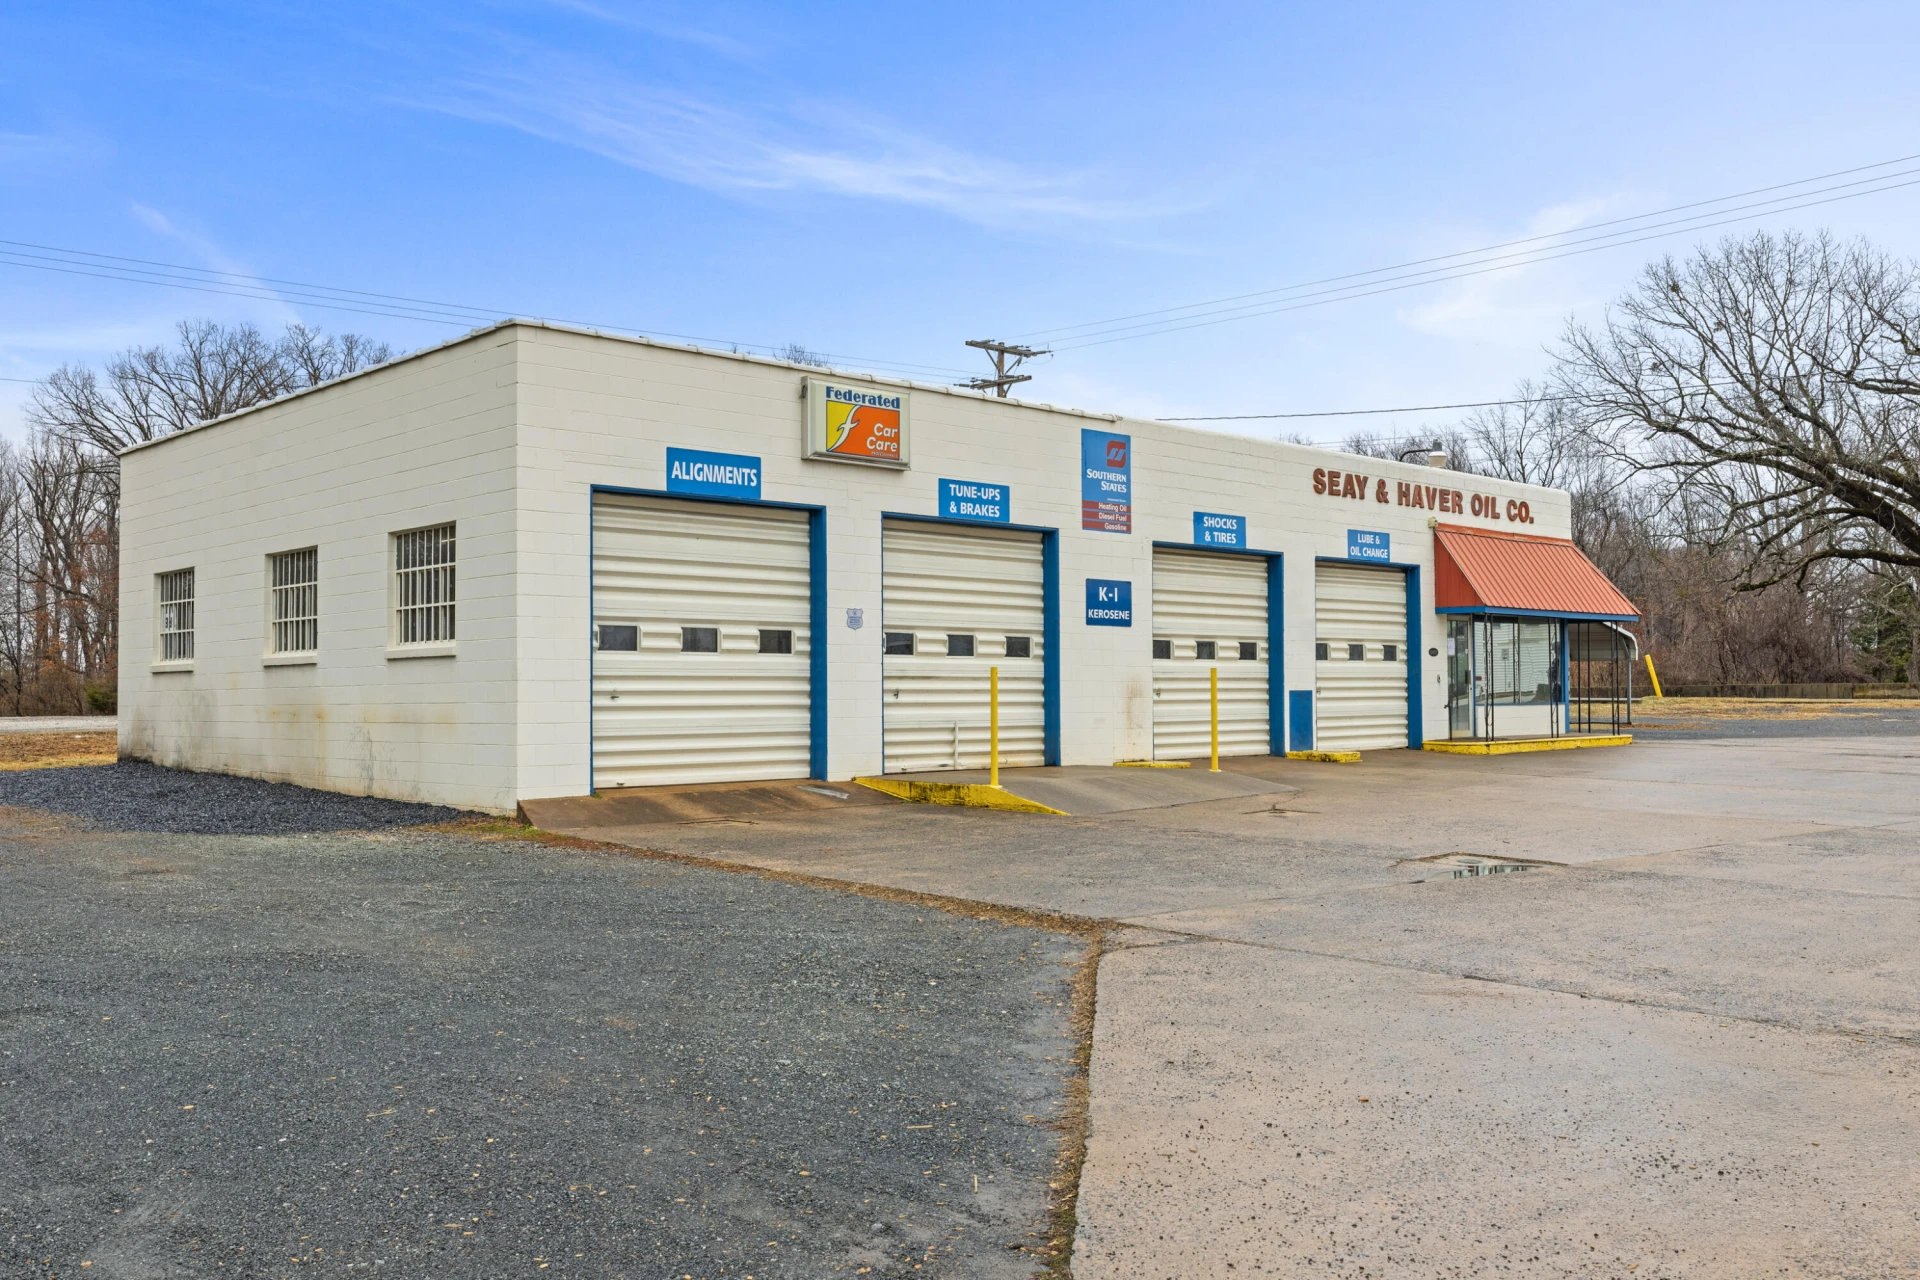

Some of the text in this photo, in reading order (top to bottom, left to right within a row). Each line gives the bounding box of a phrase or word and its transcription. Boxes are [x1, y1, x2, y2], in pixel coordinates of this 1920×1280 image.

[826, 386, 900, 409] Federated
[874, 423, 898, 438] Car
[866, 436, 898, 452] Care
[671, 461, 757, 487] ALIGNMENTS
[1086, 468, 1127, 482] SOUTHERN
[949, 484, 1000, 501] TUNE-UPS
[1101, 480, 1127, 493] STATES
[1313, 468, 1534, 524] SEAY & HAVER OIL CO.
[950, 501, 1000, 518] & BRAKES
[1098, 502, 1127, 512] Heating Oil
[1098, 512, 1128, 522] Diesel Fuel
[1203, 516, 1237, 530] SHOCKS
[1104, 522, 1127, 531] Gasoline
[1204, 530, 1237, 544] & TIRES
[1357, 533, 1380, 545] LUBE &
[1350, 545, 1388, 559] OIL CHANGE
[1088, 608, 1130, 620] KEROSENE
